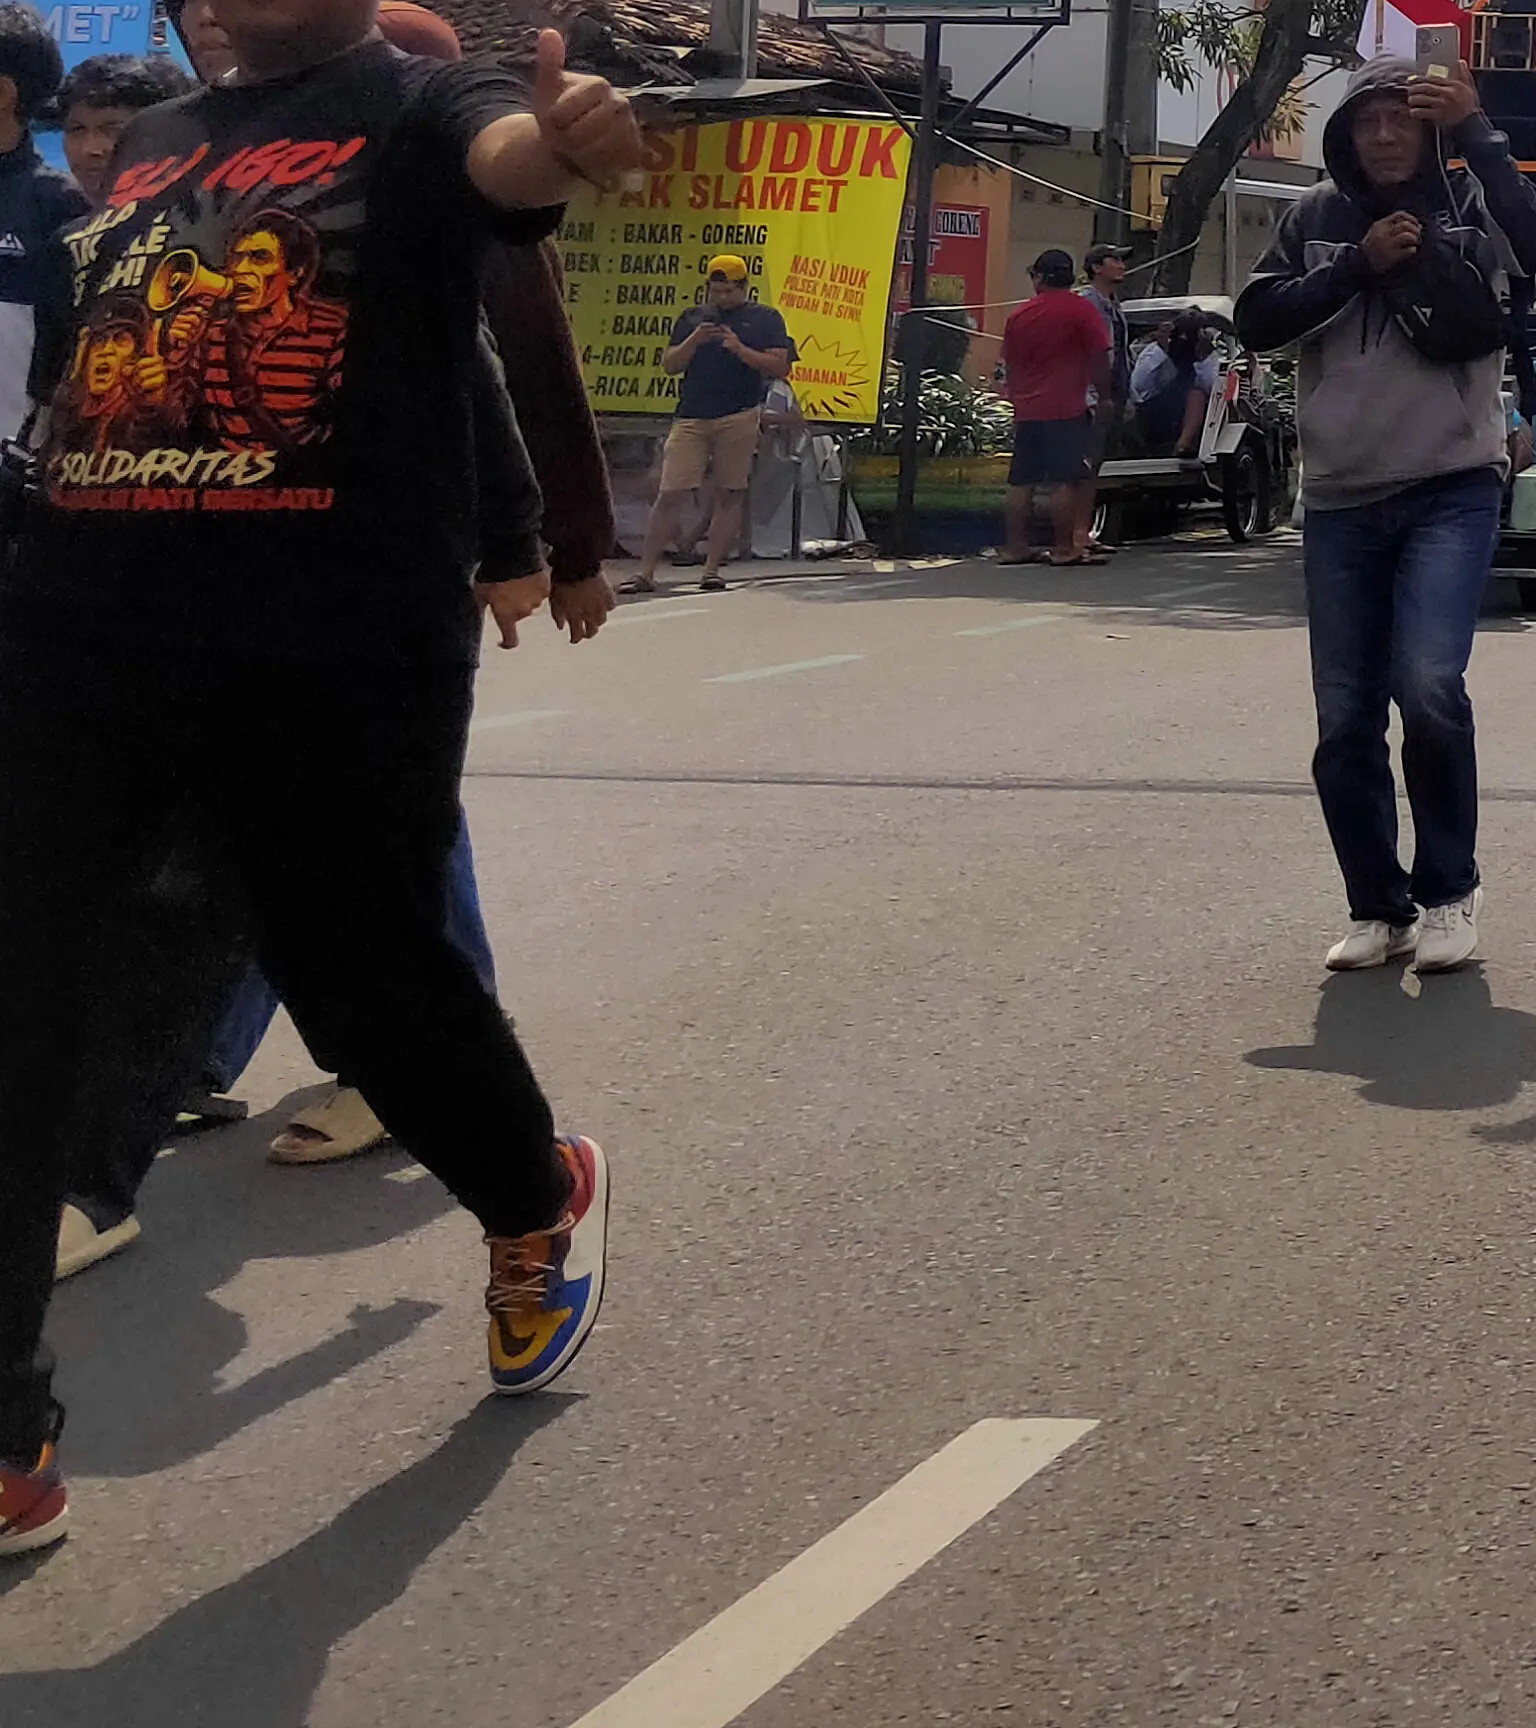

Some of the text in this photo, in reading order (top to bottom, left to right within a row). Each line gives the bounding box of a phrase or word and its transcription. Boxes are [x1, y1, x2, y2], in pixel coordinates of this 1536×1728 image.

[724, 119, 905, 180] UDUK
[688, 175, 849, 214] SLAMET
[624, 223, 683, 244] BAKAR
[702, 224, 768, 245] GORENG
[620, 254, 680, 275] BAKAR
[790, 255, 826, 280] NASI
[616, 284, 676, 305] BAKAR
[644, 377, 682, 398] AYA
[58, 446, 278, 486] SOLIDARITAS
